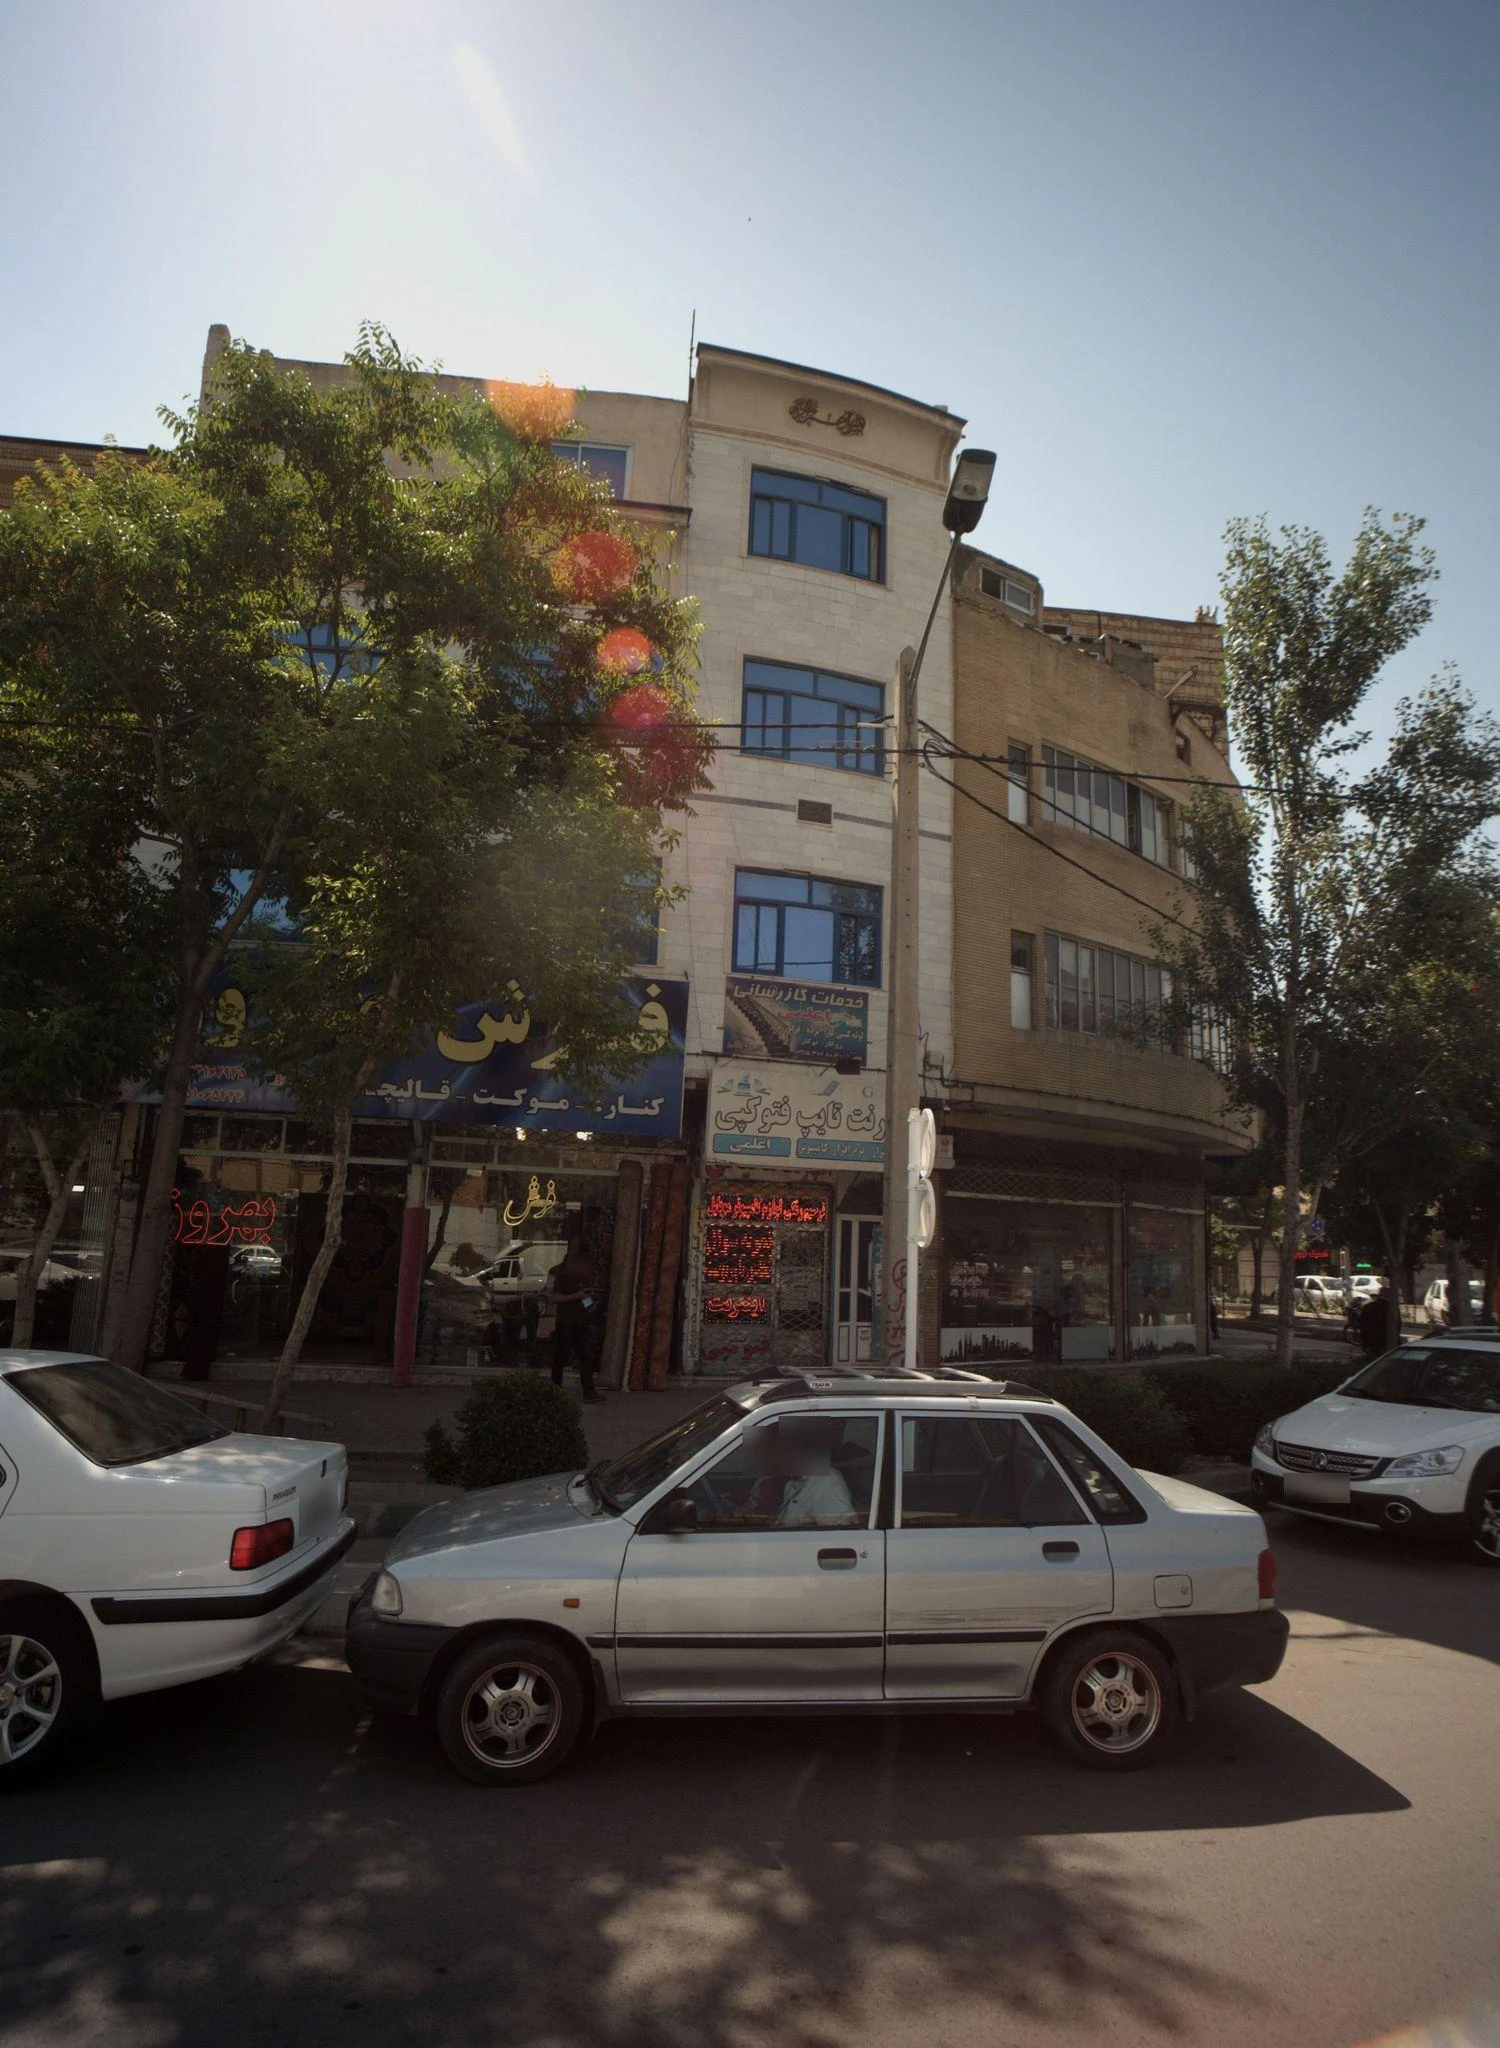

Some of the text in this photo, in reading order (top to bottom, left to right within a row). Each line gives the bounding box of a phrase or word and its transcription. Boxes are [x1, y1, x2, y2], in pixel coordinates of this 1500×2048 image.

[812, 991, 864, 1008] خدمات
[361, 1079, 452, 1103] قالیچ
[472, 1088, 569, 1114] موکت
[796, 1100, 843, 1138] تایپ
[730, 1137, 771, 1152] اعلمی
[504, 1175, 556, 1226] فرش
[171, 1186, 275, 1246] بهروز
